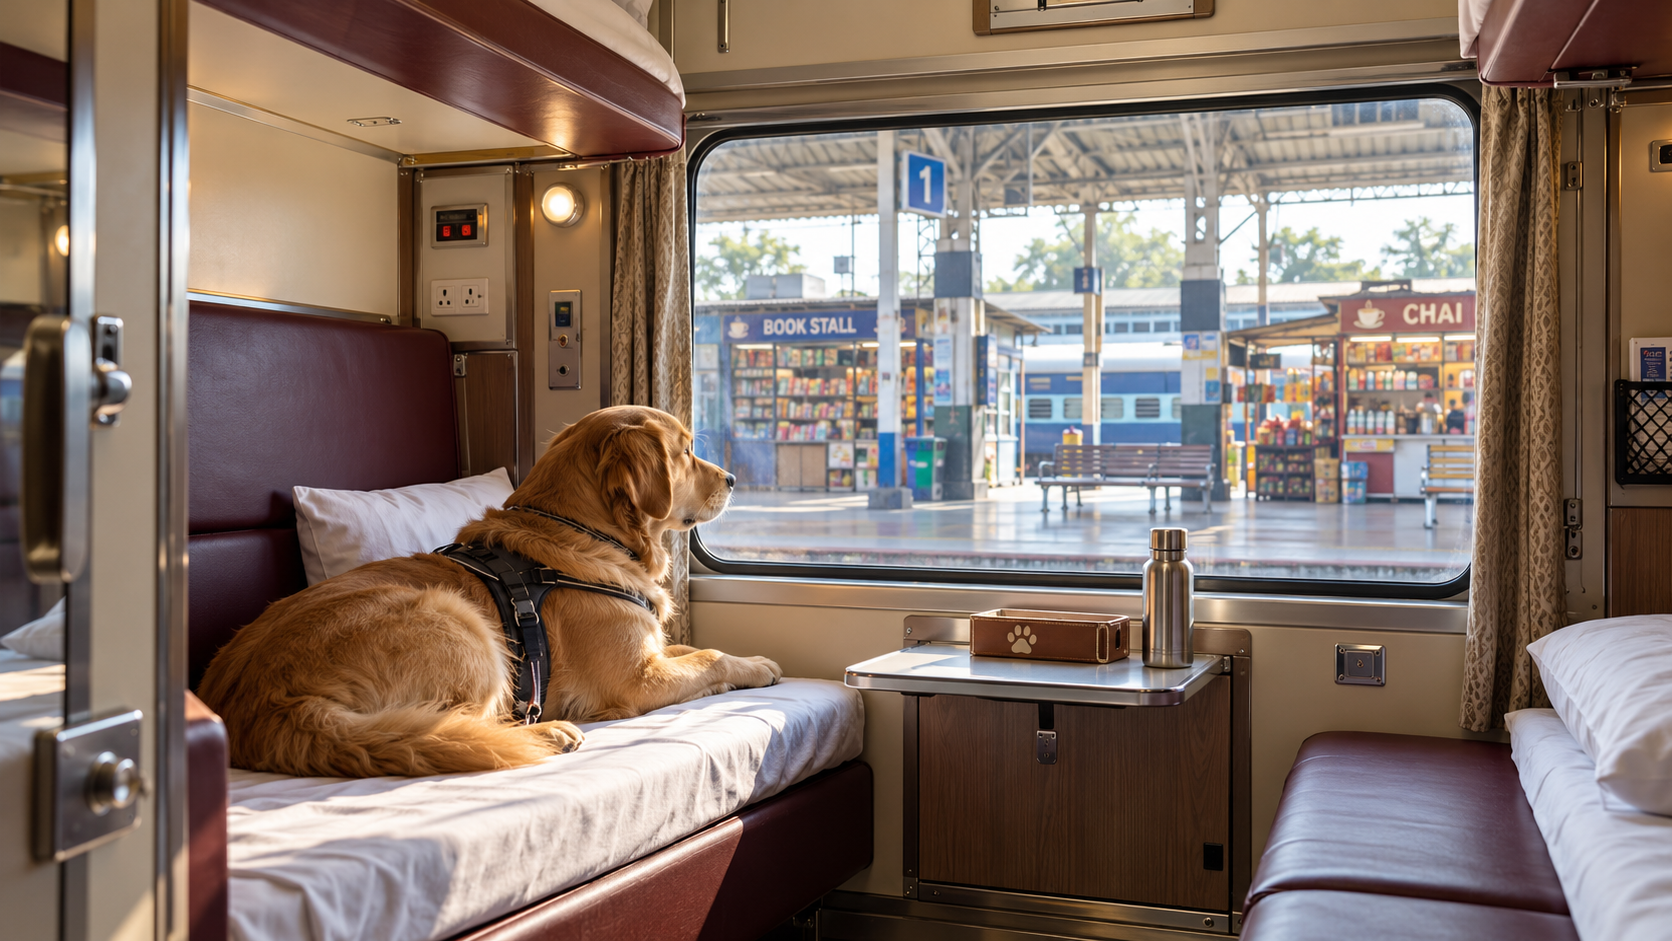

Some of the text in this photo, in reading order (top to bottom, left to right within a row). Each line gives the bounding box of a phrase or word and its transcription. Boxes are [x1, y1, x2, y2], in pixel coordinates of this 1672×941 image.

[919, 165, 931, 204] 1
[1403, 302, 1462, 325] CHAI
[763, 317, 857, 335] BOOK STALL
